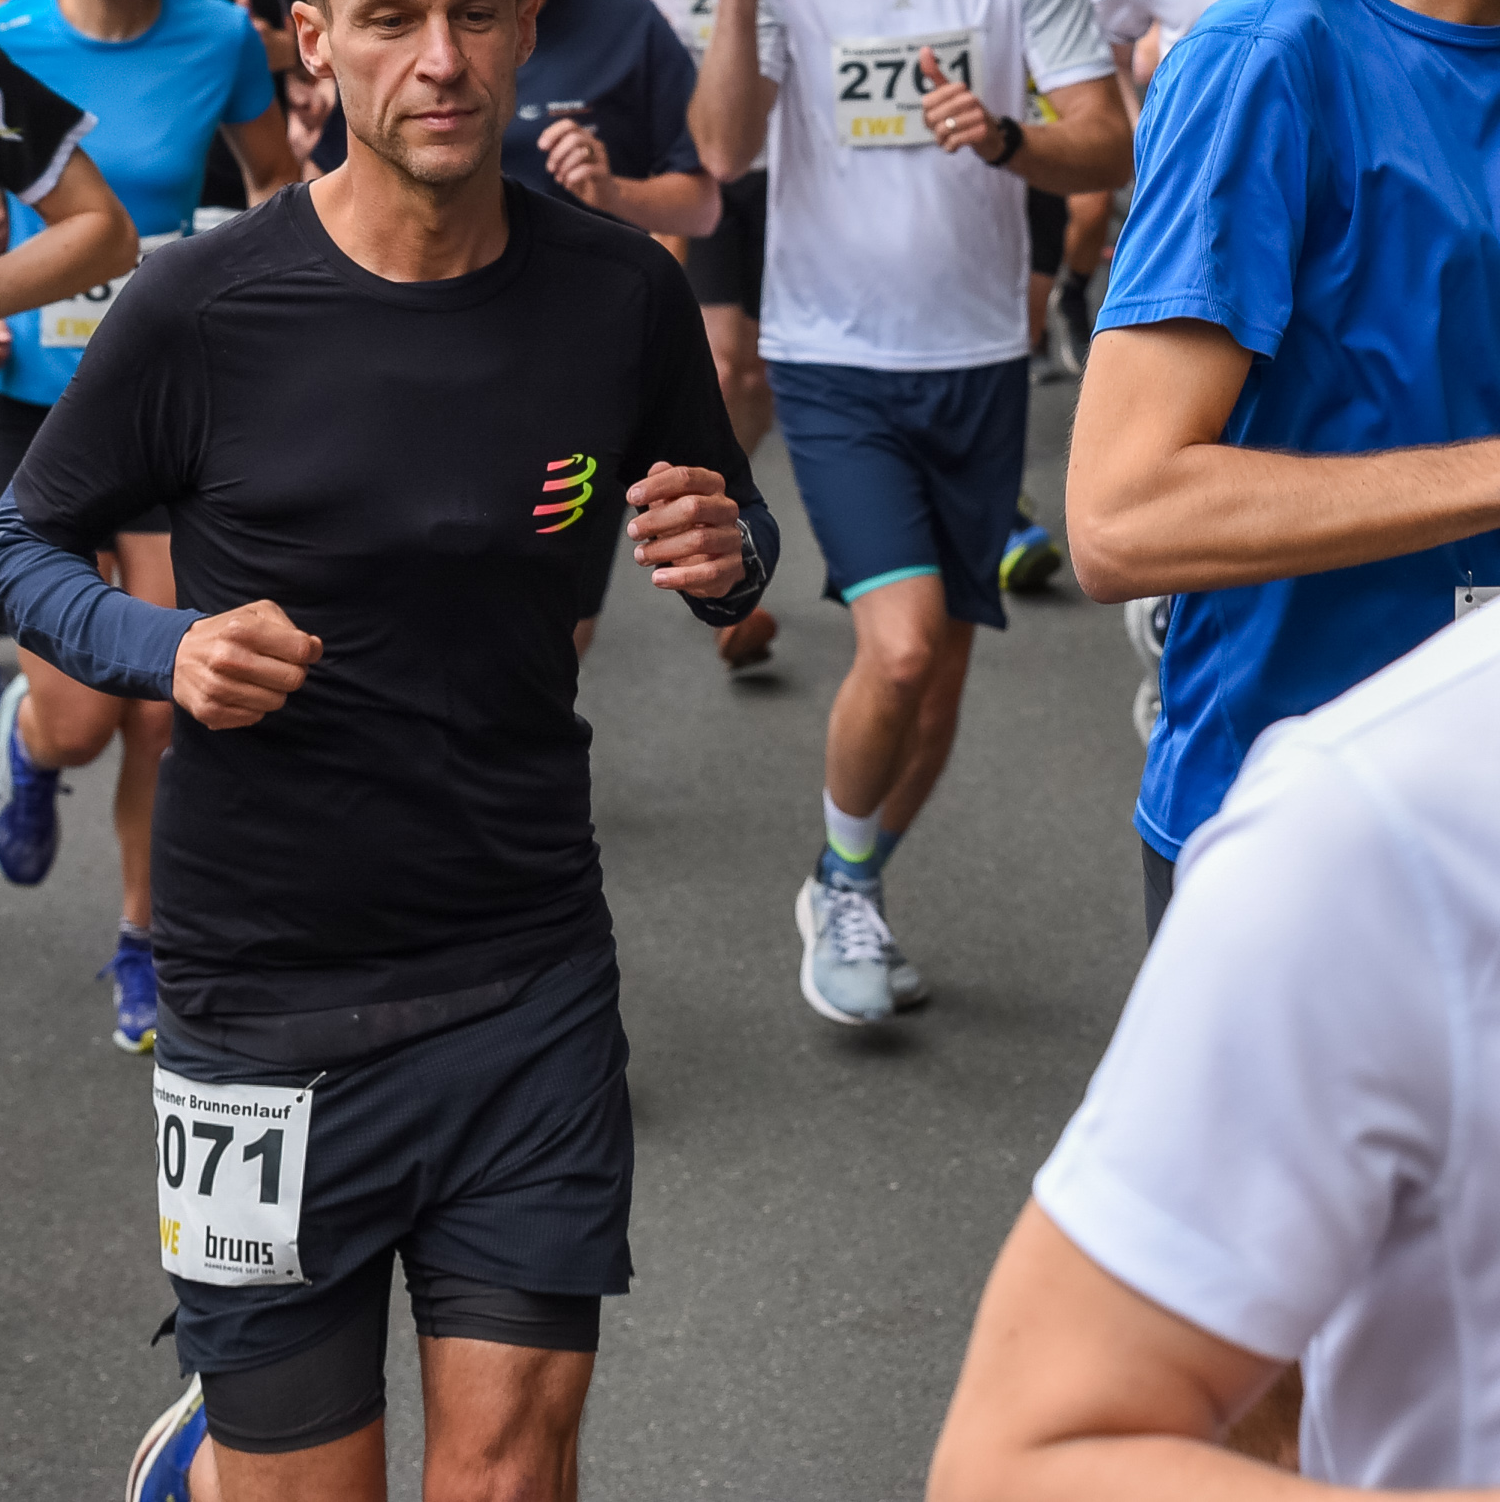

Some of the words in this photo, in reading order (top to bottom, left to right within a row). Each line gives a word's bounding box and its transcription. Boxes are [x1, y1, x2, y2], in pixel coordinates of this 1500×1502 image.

[839, 49, 973, 102] 2761
[852, 115, 906, 138] EWE
[190, 1094, 292, 1120] Brunnenlauf
[156, 1113, 285, 1205] 071
[160, 1214, 181, 1256] WE
[204, 1225, 275, 1266] bruns
